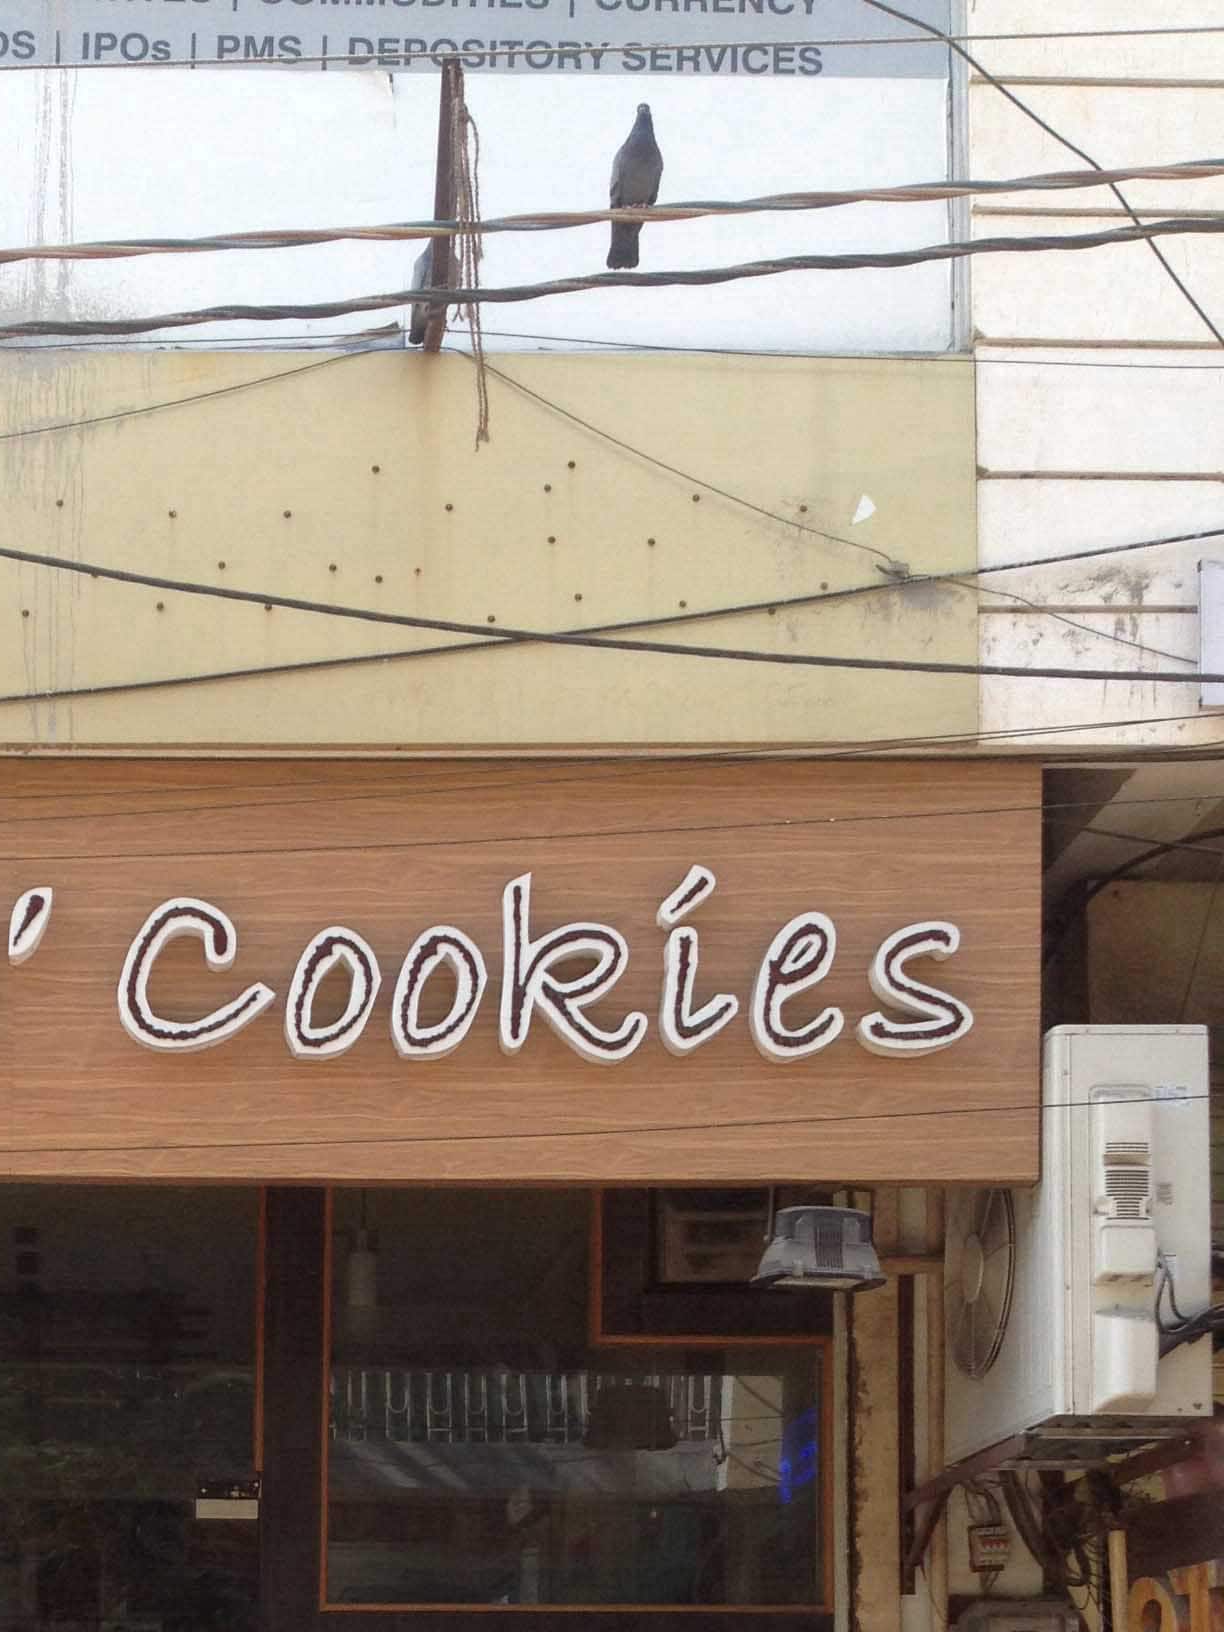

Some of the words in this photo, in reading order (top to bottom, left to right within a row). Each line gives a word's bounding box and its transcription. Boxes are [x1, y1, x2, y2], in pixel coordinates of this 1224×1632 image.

[82, 32, 171, 61] IPOs
[216, 35, 302, 61] PMS
[348, 37, 611, 70] DEPOSITORY
[622, 42, 824, 76] SERVICES
[117, 864, 973, 1064] Cookies
